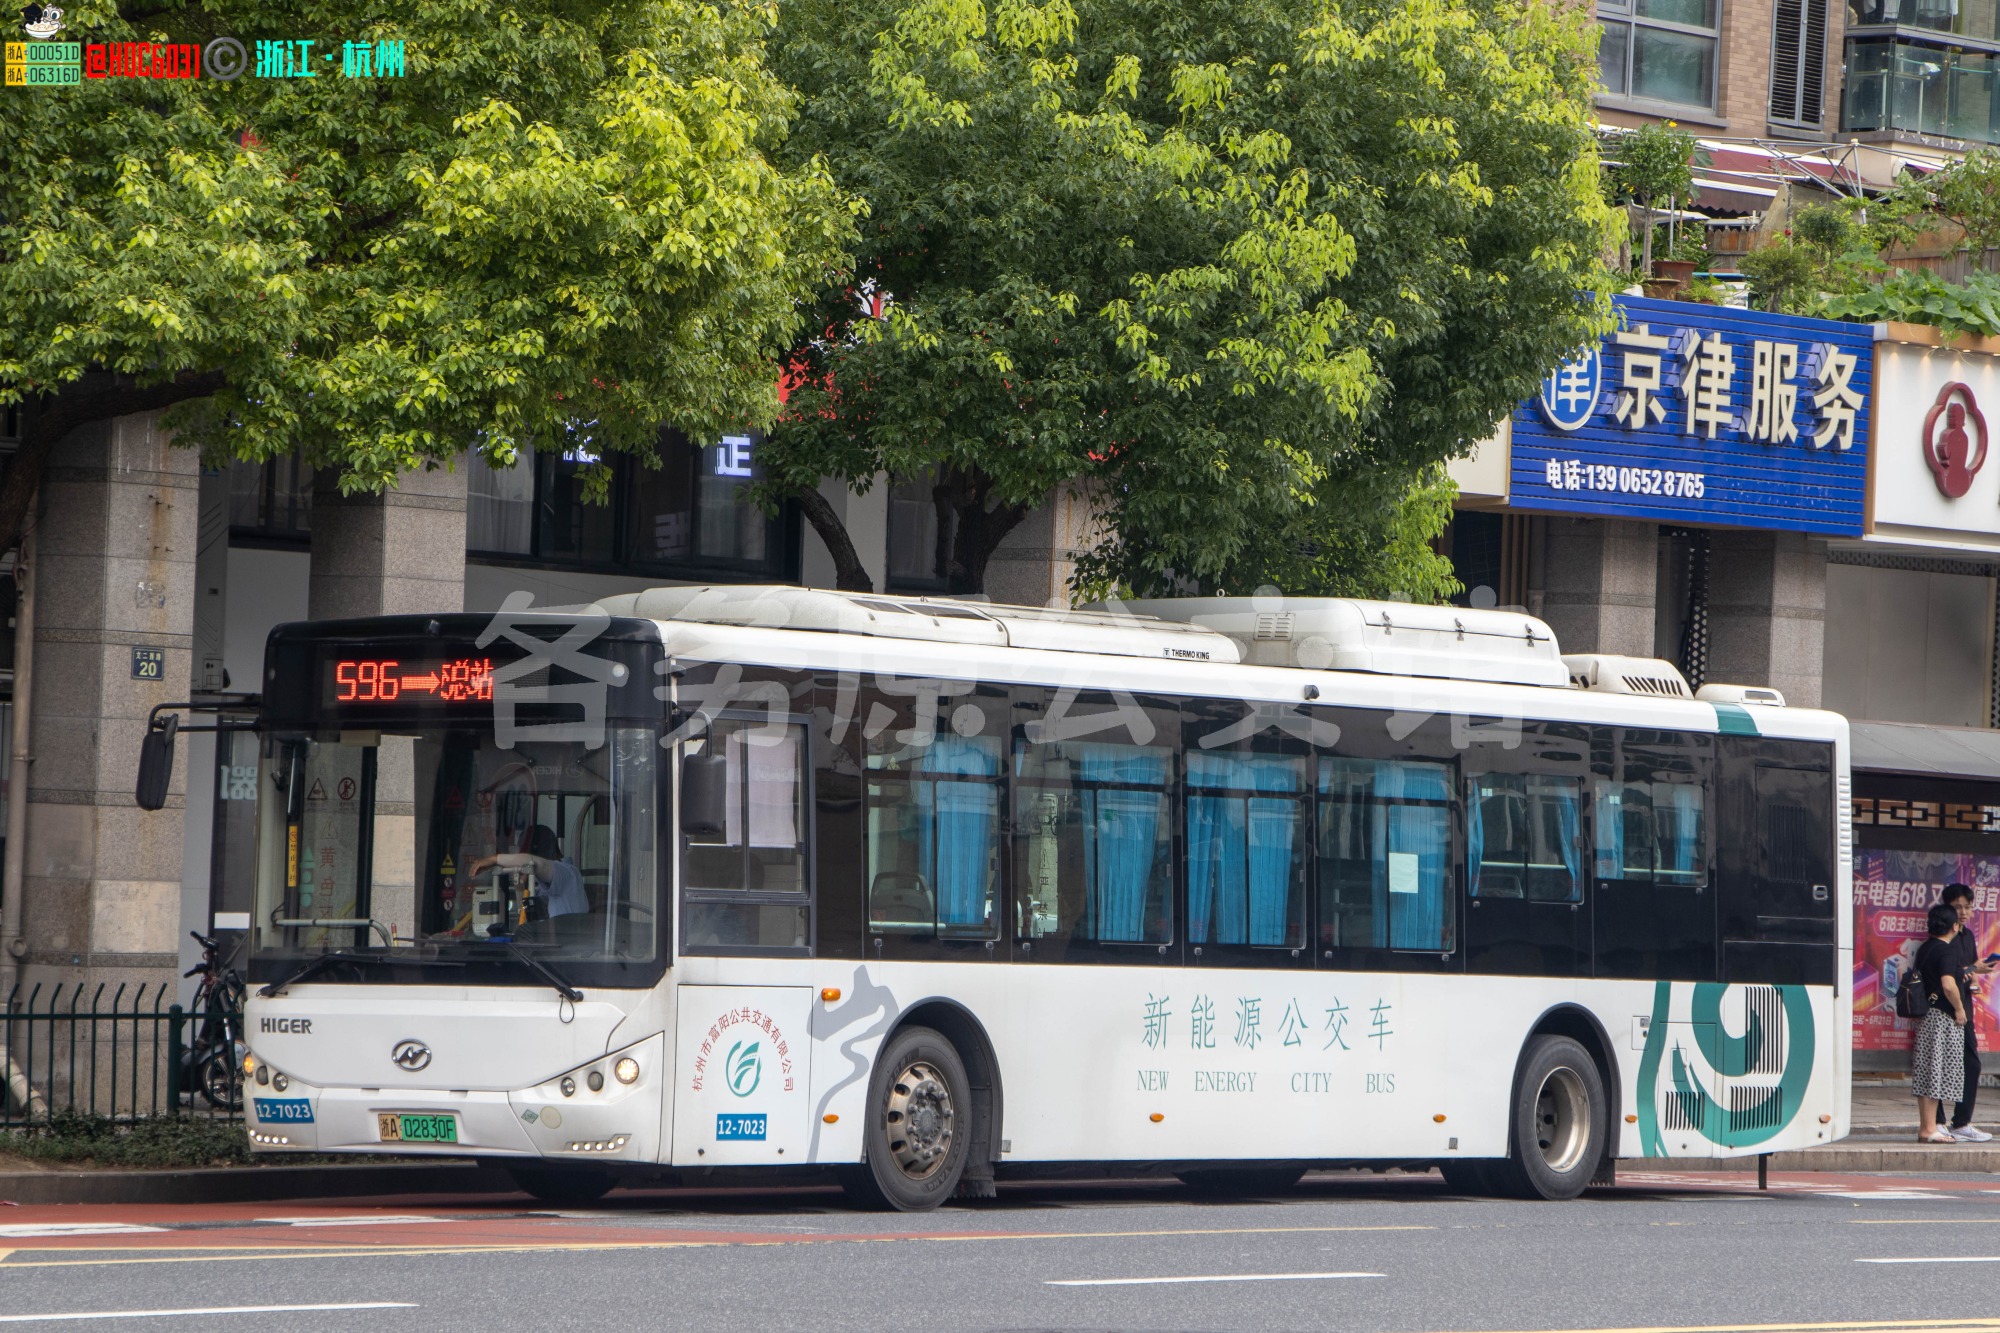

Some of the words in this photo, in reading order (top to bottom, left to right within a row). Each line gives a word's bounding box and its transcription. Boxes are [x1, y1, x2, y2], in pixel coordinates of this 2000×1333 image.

[1614, 323, 1865, 450] 京律服务
[1171, 649, 1195, 658] THERMO
[1196, 651, 1210, 660] KING
[139, 661, 157, 677] 20
[336, 661, 399, 700] 596
[1853, 880, 1927, 909] 东电器618
[260, 1017, 312, 1034] HIGER
[1141, 992, 1395, 1052] 新能源公交车
[691, 1006, 794, 1092] 杭州市富阳公共交通有限公司
[1136, 1069, 1170, 1092] NEW
[1194, 1070, 1257, 1093] ENERGY
[1291, 1072, 1333, 1093] CITY
[1365, 1073, 1396, 1094] BUS
[256, 1103, 312, 1120] 12-7023
[718, 1119, 766, 1136] 12-7023
